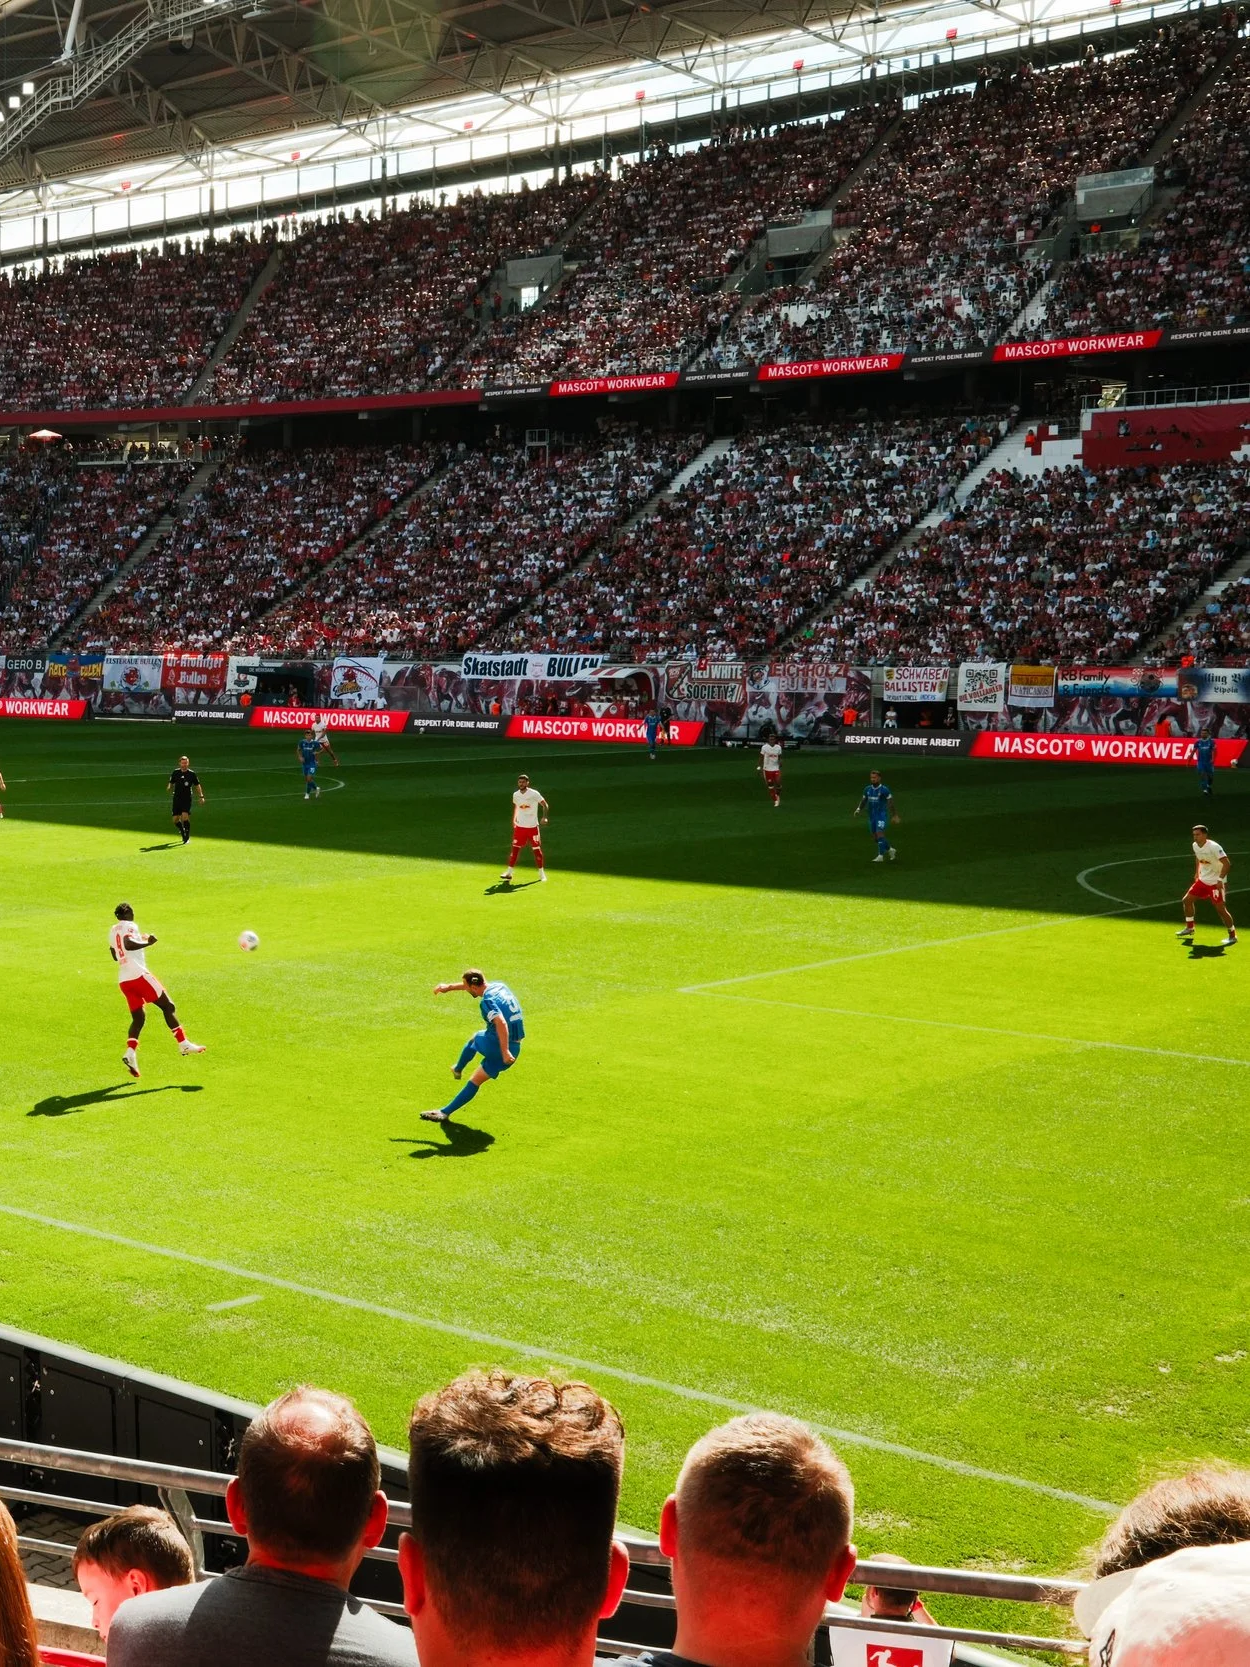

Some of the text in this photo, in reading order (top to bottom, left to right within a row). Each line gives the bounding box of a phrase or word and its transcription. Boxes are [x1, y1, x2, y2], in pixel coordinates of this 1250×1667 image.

[1068, 335, 1144, 352] WORKWEAR
[822, 358, 888, 372] WORKWEAR
[607, 376, 665, 389] WORKWEAR
[7, 660, 44, 670] GERO B.
[464, 656, 528, 676] Skatstadt
[773, 664, 845, 677] EICHHOLZ
[179, 672, 207, 685] Bullen
[710, 665, 742, 679] WHITE
[896, 668, 949, 680] SCHWABEN
[1061, 670, 1077, 681] RB
[1079, 670, 1110, 685] Family
[778, 678, 837, 691] BULLEN
[885, 681, 937, 692] BALLISTEN
[1063, 684, 1110, 695] & Friends
[686, 684, 729, 700] SOCIETY
[6, 701, 68, 716] WORKWEAR
[320, 713, 390, 728] WORKWEAR
[442, 719, 455, 727] FÜR
[592, 723, 679, 740] WORKWR
[844, 735, 961, 747] RESPEKT FÜR DEINE ARBEIT
[1091, 740, 1198, 760] WORKWEA
